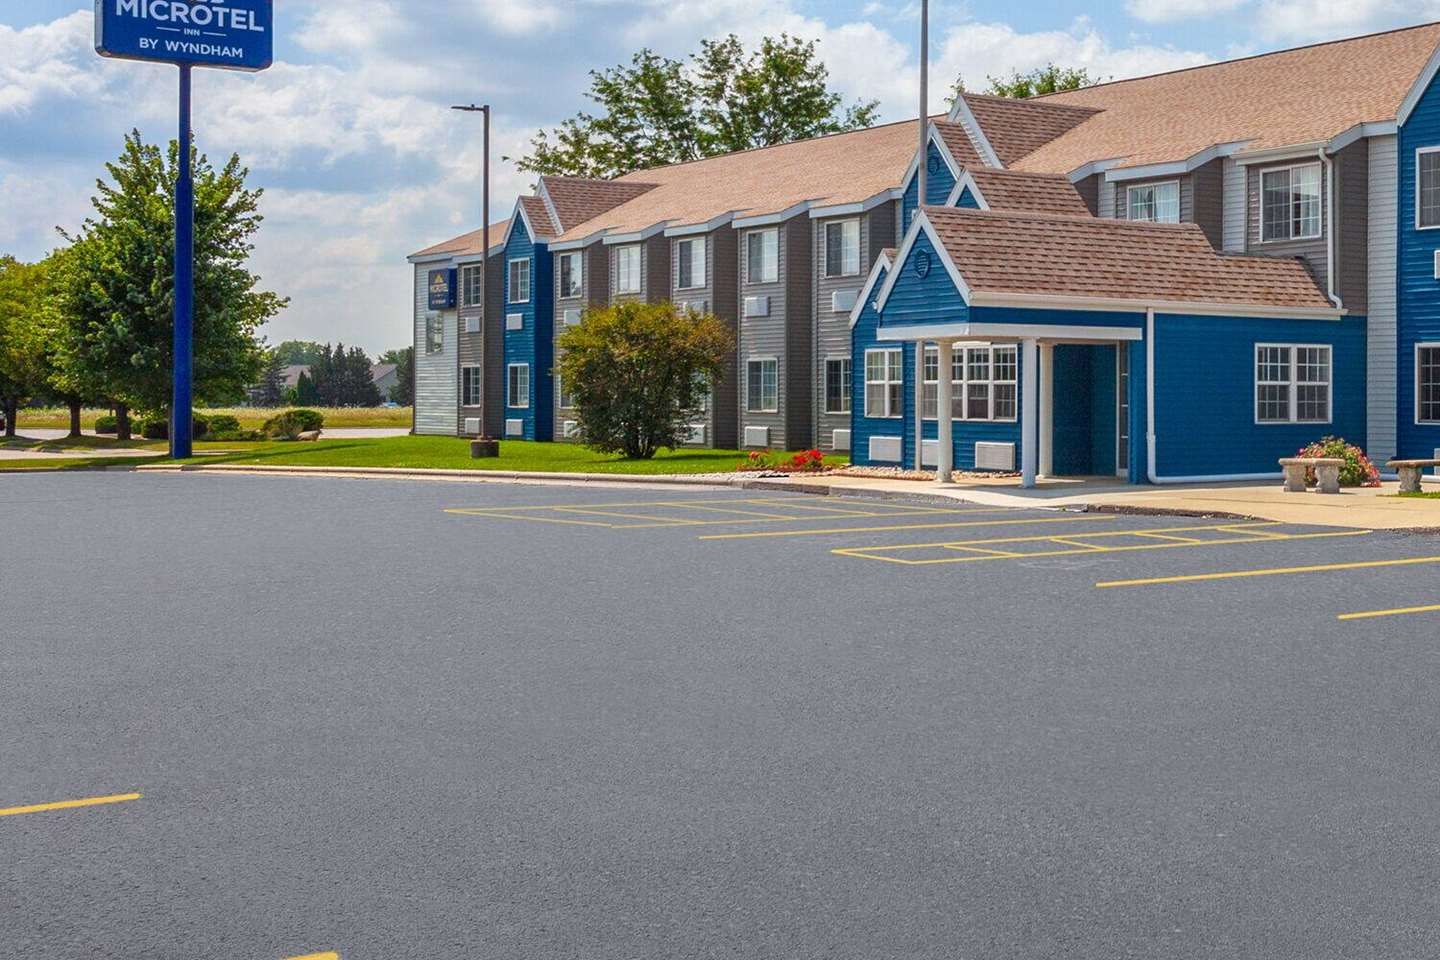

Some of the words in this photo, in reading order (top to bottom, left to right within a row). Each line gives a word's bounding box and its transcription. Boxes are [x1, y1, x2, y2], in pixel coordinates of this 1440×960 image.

[184, 28, 200, 36] INN
[139, 37, 158, 49] BY
[165, 40, 243, 58] WYNDHAM
